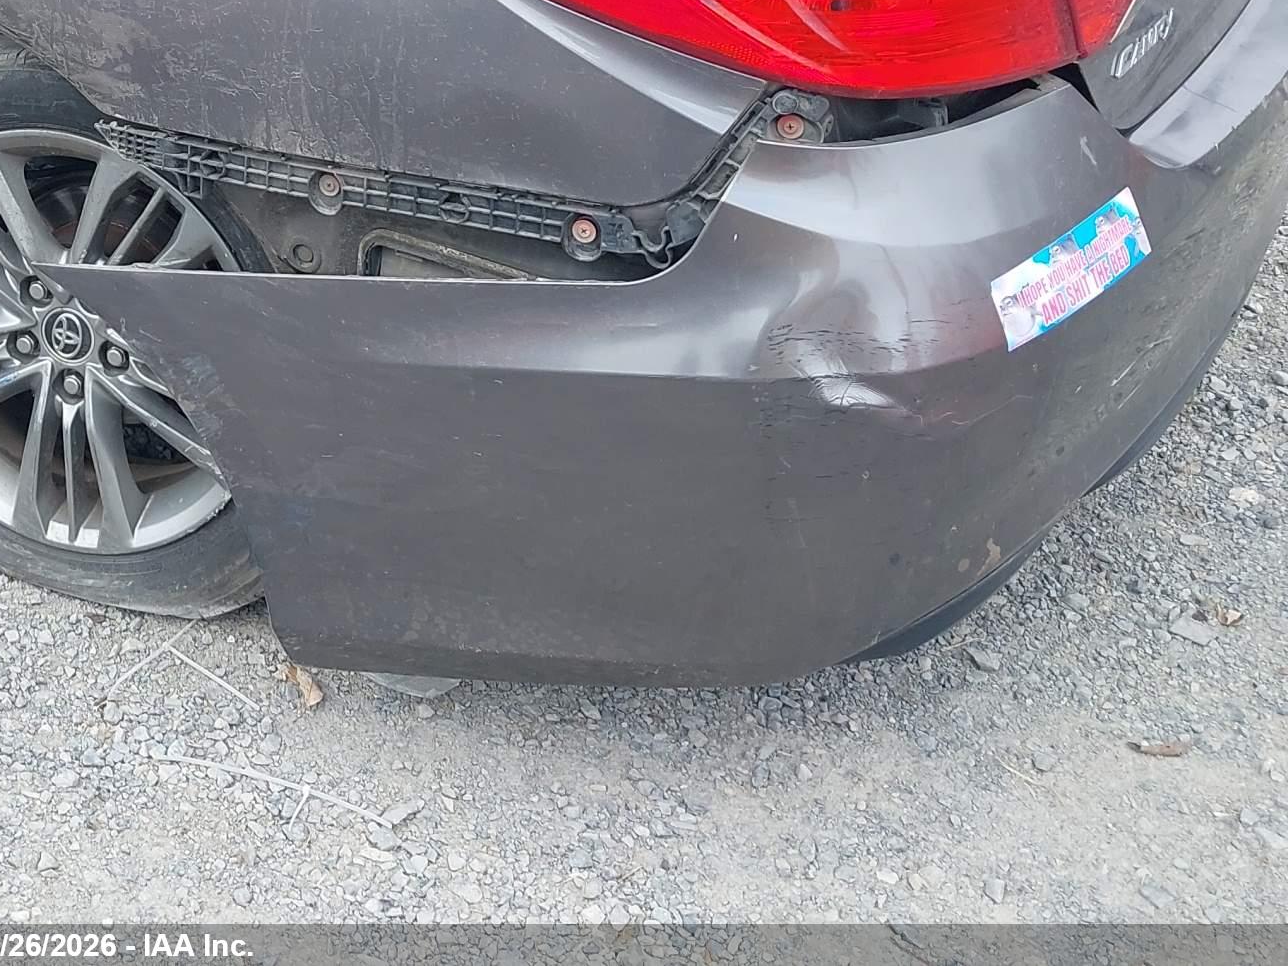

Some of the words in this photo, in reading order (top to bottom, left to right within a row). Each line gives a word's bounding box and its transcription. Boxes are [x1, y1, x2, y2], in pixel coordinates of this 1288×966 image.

[1042, 293, 1068, 324] AND
[1066, 275, 1091, 306] SHIT
[1090, 261, 1112, 288] THE
[1110, 247, 1129, 276] BED
[1064, 251, 1087, 277] HAVE
